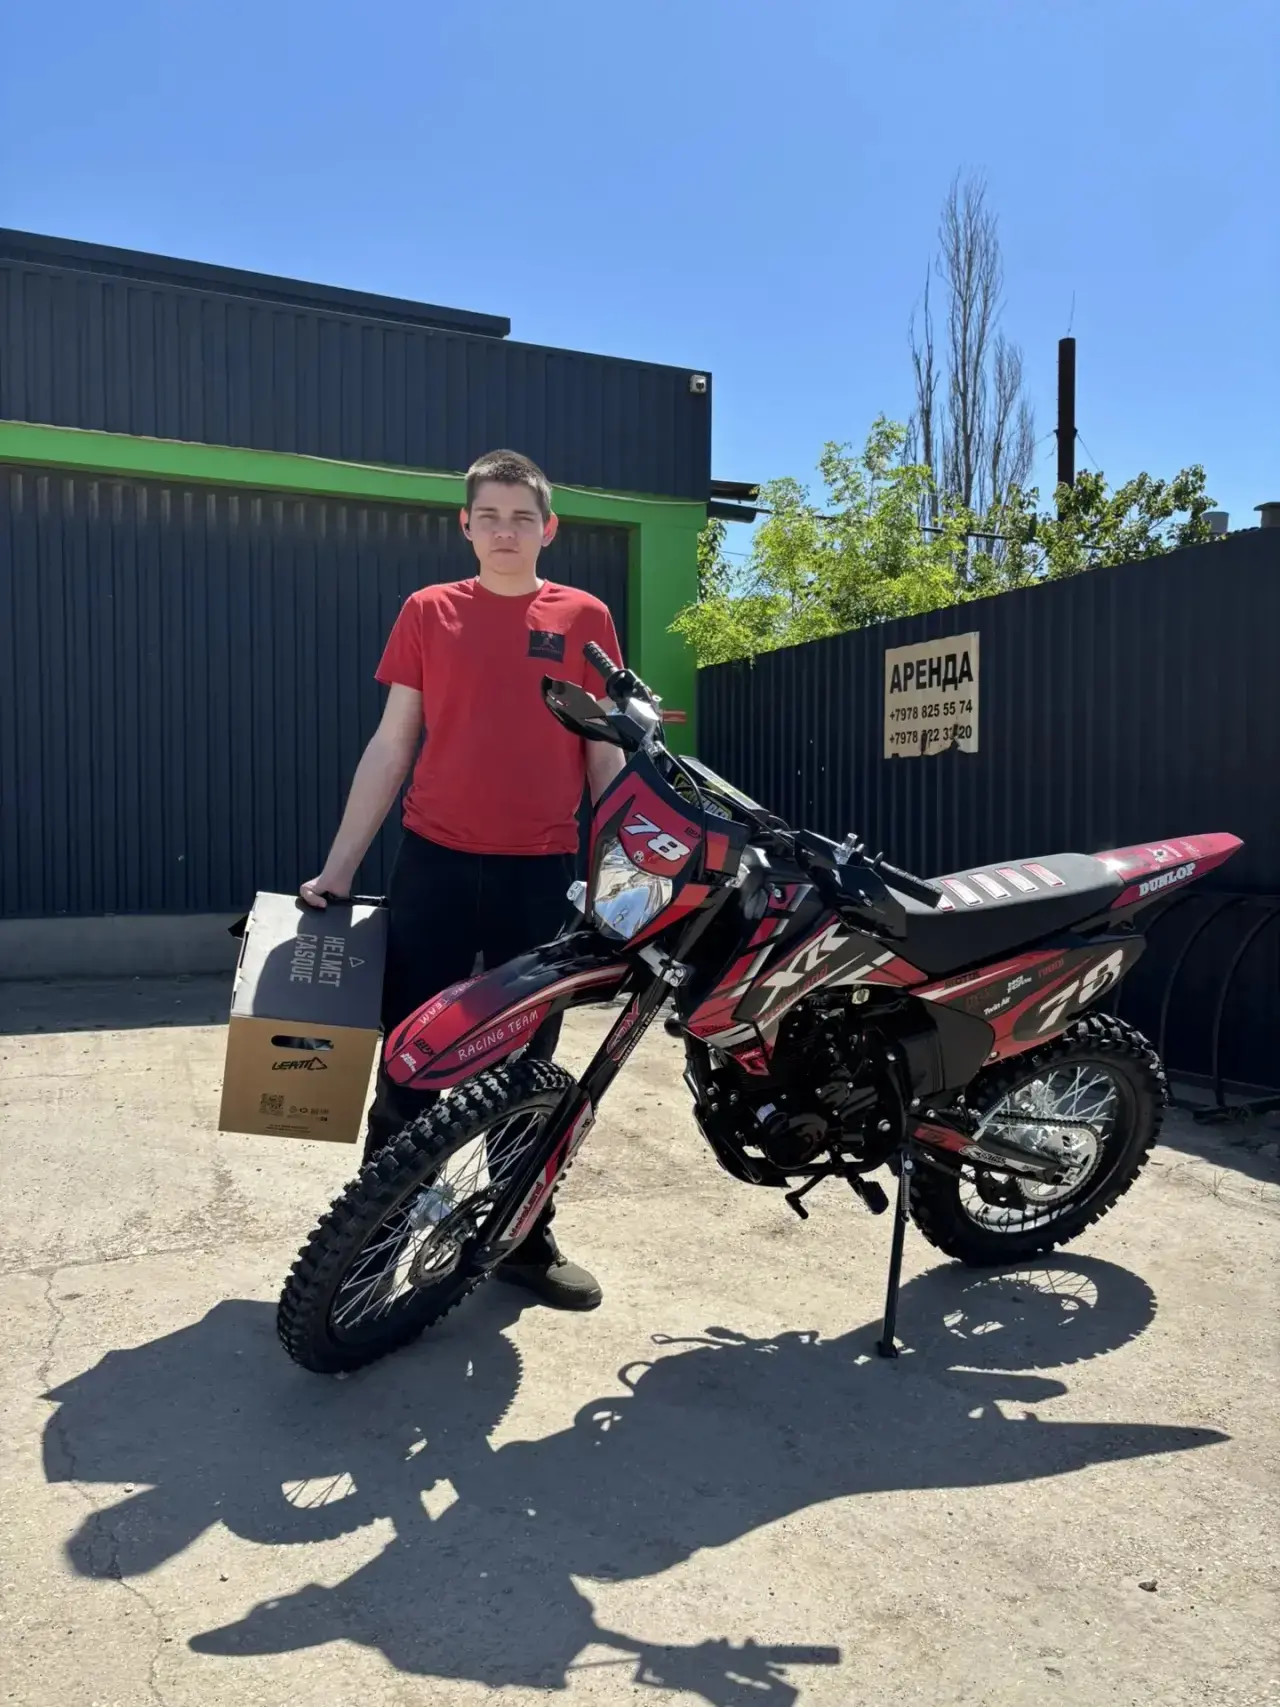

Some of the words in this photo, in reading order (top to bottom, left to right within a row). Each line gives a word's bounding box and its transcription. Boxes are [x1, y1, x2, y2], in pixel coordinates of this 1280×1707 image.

[890, 651, 973, 694] АРЕНДА
[890, 706, 918, 722] +7978
[921, 704, 940, 719] 825
[943, 701, 956, 716] 55
[959, 699, 973, 714] 74
[889, 730, 918, 745] +7978
[921, 727, 940, 743] 22
[622, 812, 691, 862] 78
[1139, 862, 1196, 896] DUNLOP
[290, 934, 319, 984] CASQUE
[318, 935, 345, 987] HELMET
[983, 1001, 1001, 1016] Twin
[1000, 996, 1012, 1009] Air
[457, 1029, 505, 1061] RACING
[507, 1009, 539, 1034] TEAM
